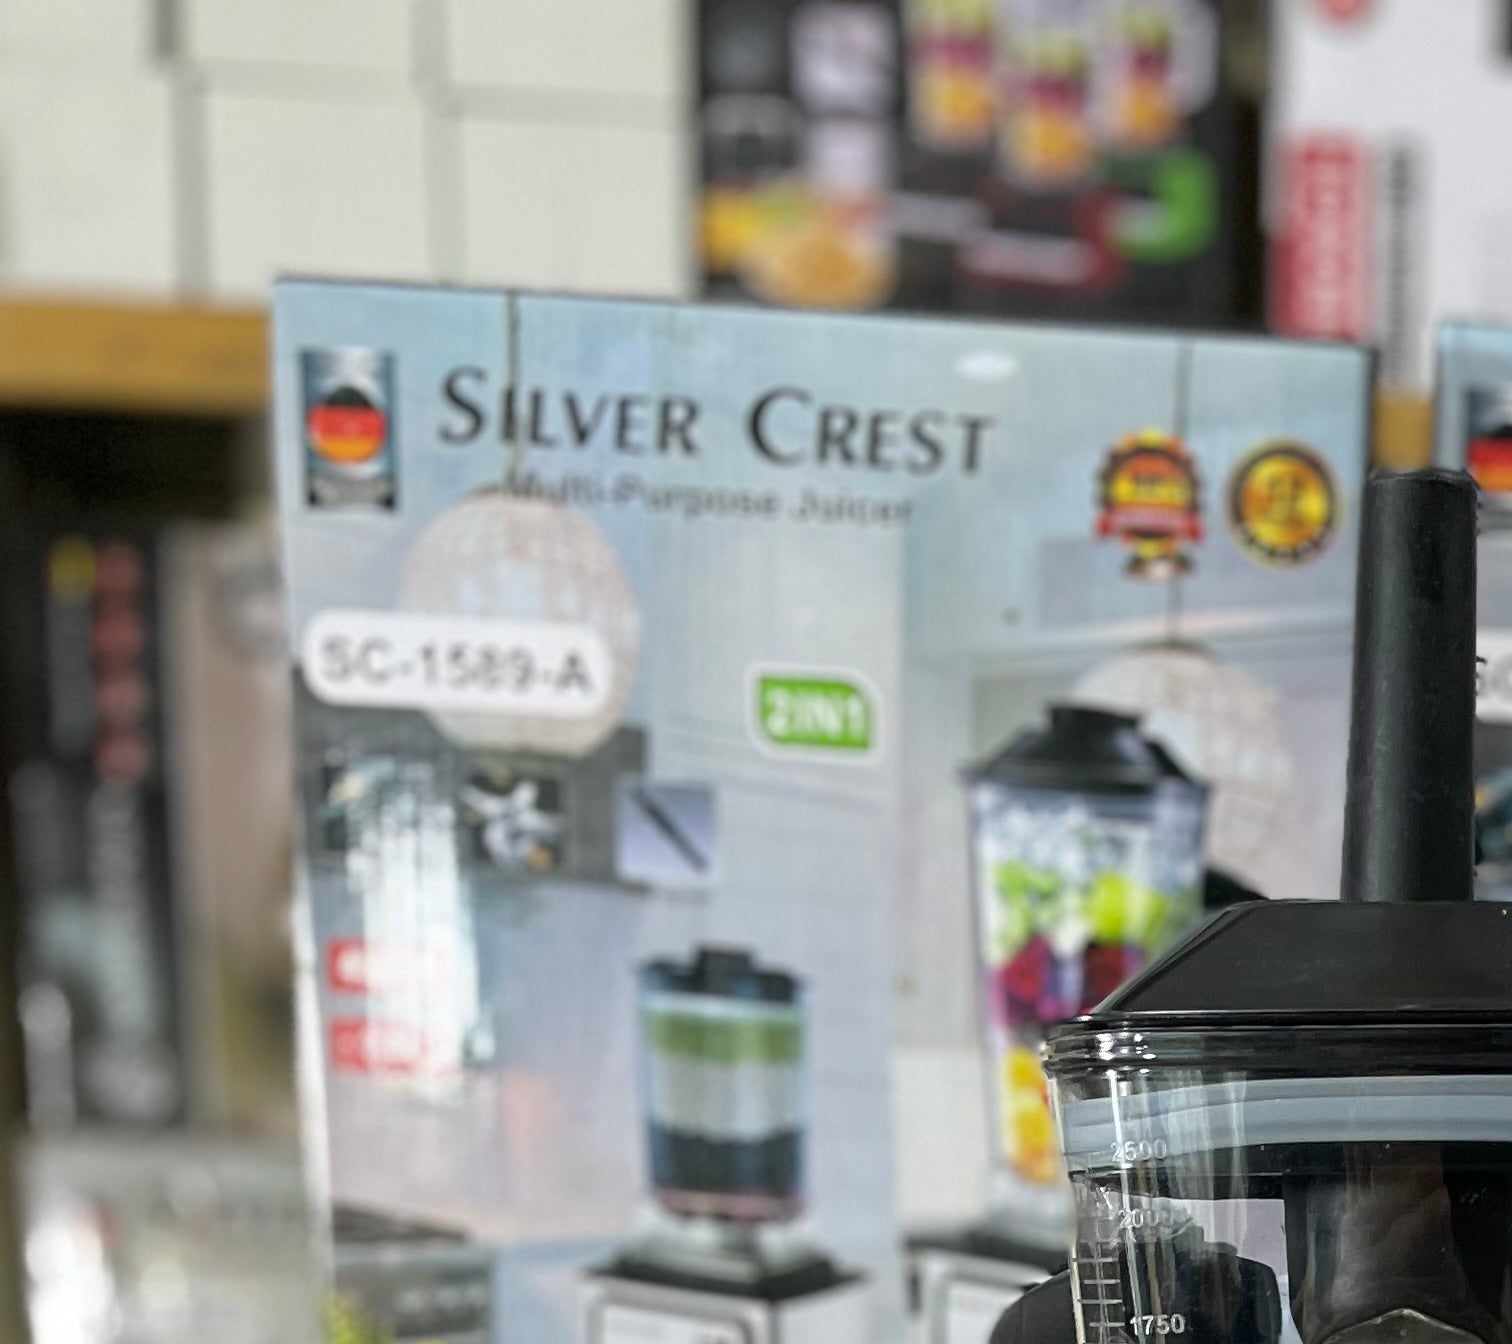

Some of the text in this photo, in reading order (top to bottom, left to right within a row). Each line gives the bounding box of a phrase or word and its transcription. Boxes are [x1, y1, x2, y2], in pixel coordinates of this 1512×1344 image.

[438, 364, 704, 458] SILVER
[745, 386, 996, 476] CREST
[320, 638, 596, 694] SC-1589-A
[1129, 1313, 1187, 1336] 1750
